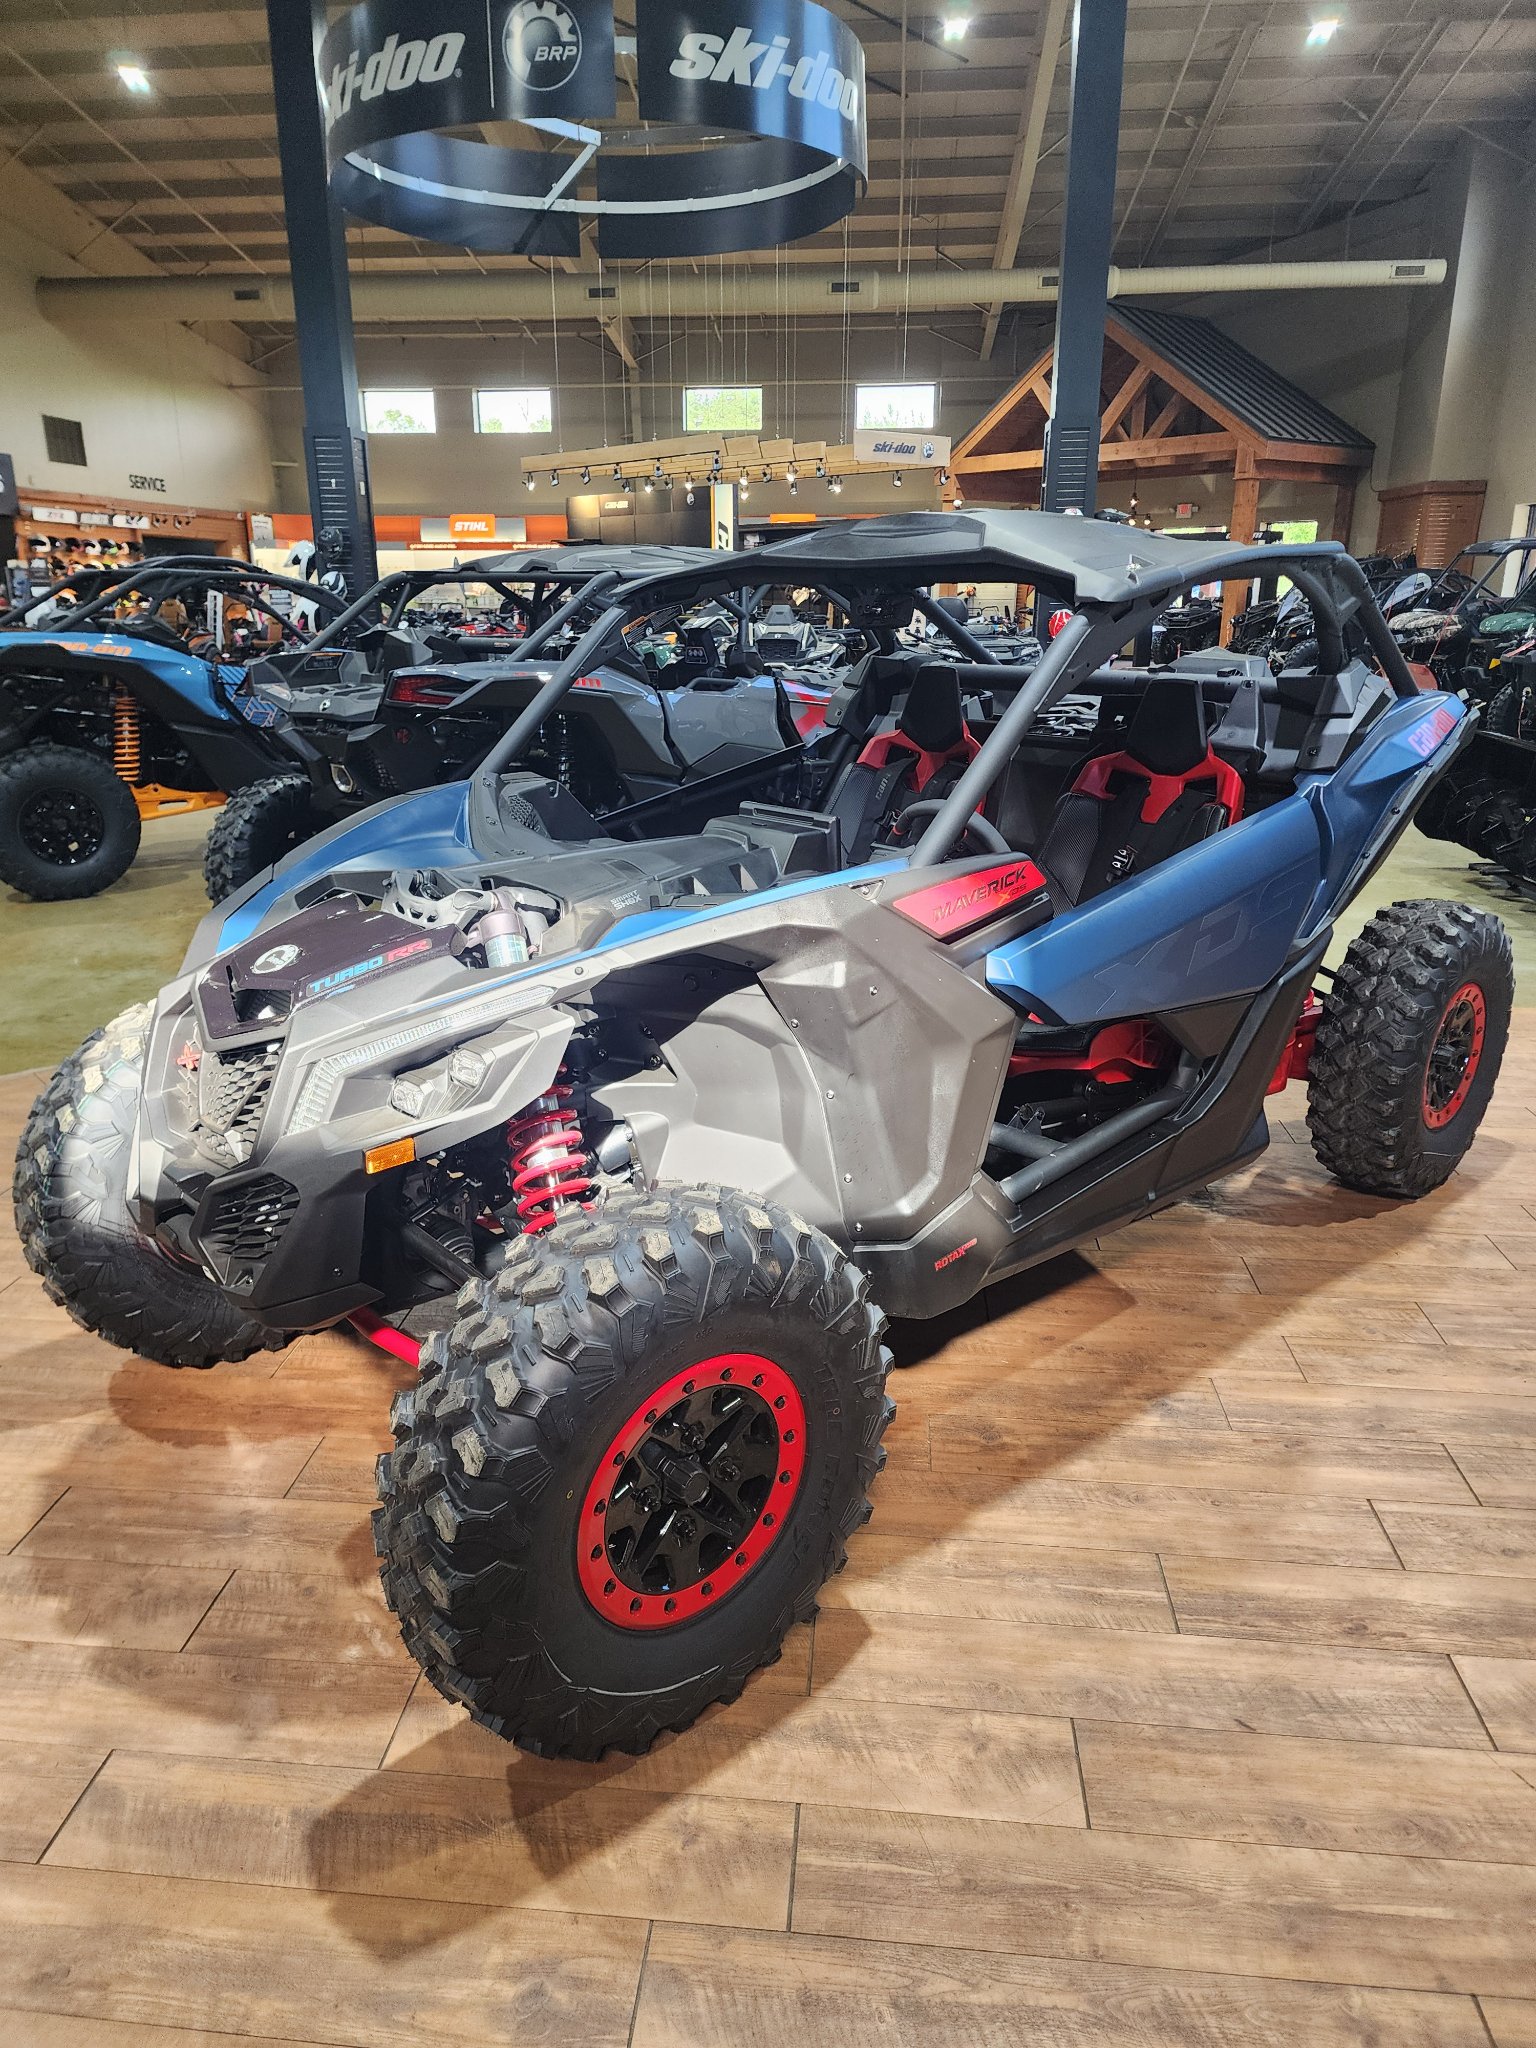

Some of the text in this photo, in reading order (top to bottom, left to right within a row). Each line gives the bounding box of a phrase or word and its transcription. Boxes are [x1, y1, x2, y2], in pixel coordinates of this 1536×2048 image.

[534, 45, 578, 62] BRP
[669, 26, 858, 122] ski-doo
[873, 441, 916, 455] ski-doo
[129, 474, 166, 492] SERVICE
[454, 521, 489, 532] STIHL
[610, 889, 638, 904] SMART
[932, 864, 1028, 922] MAVERICK
[613, 894, 642, 910] SHOX
[309, 938, 429, 993] TURBO RR
[934, 1243, 966, 1271] ROTAX
